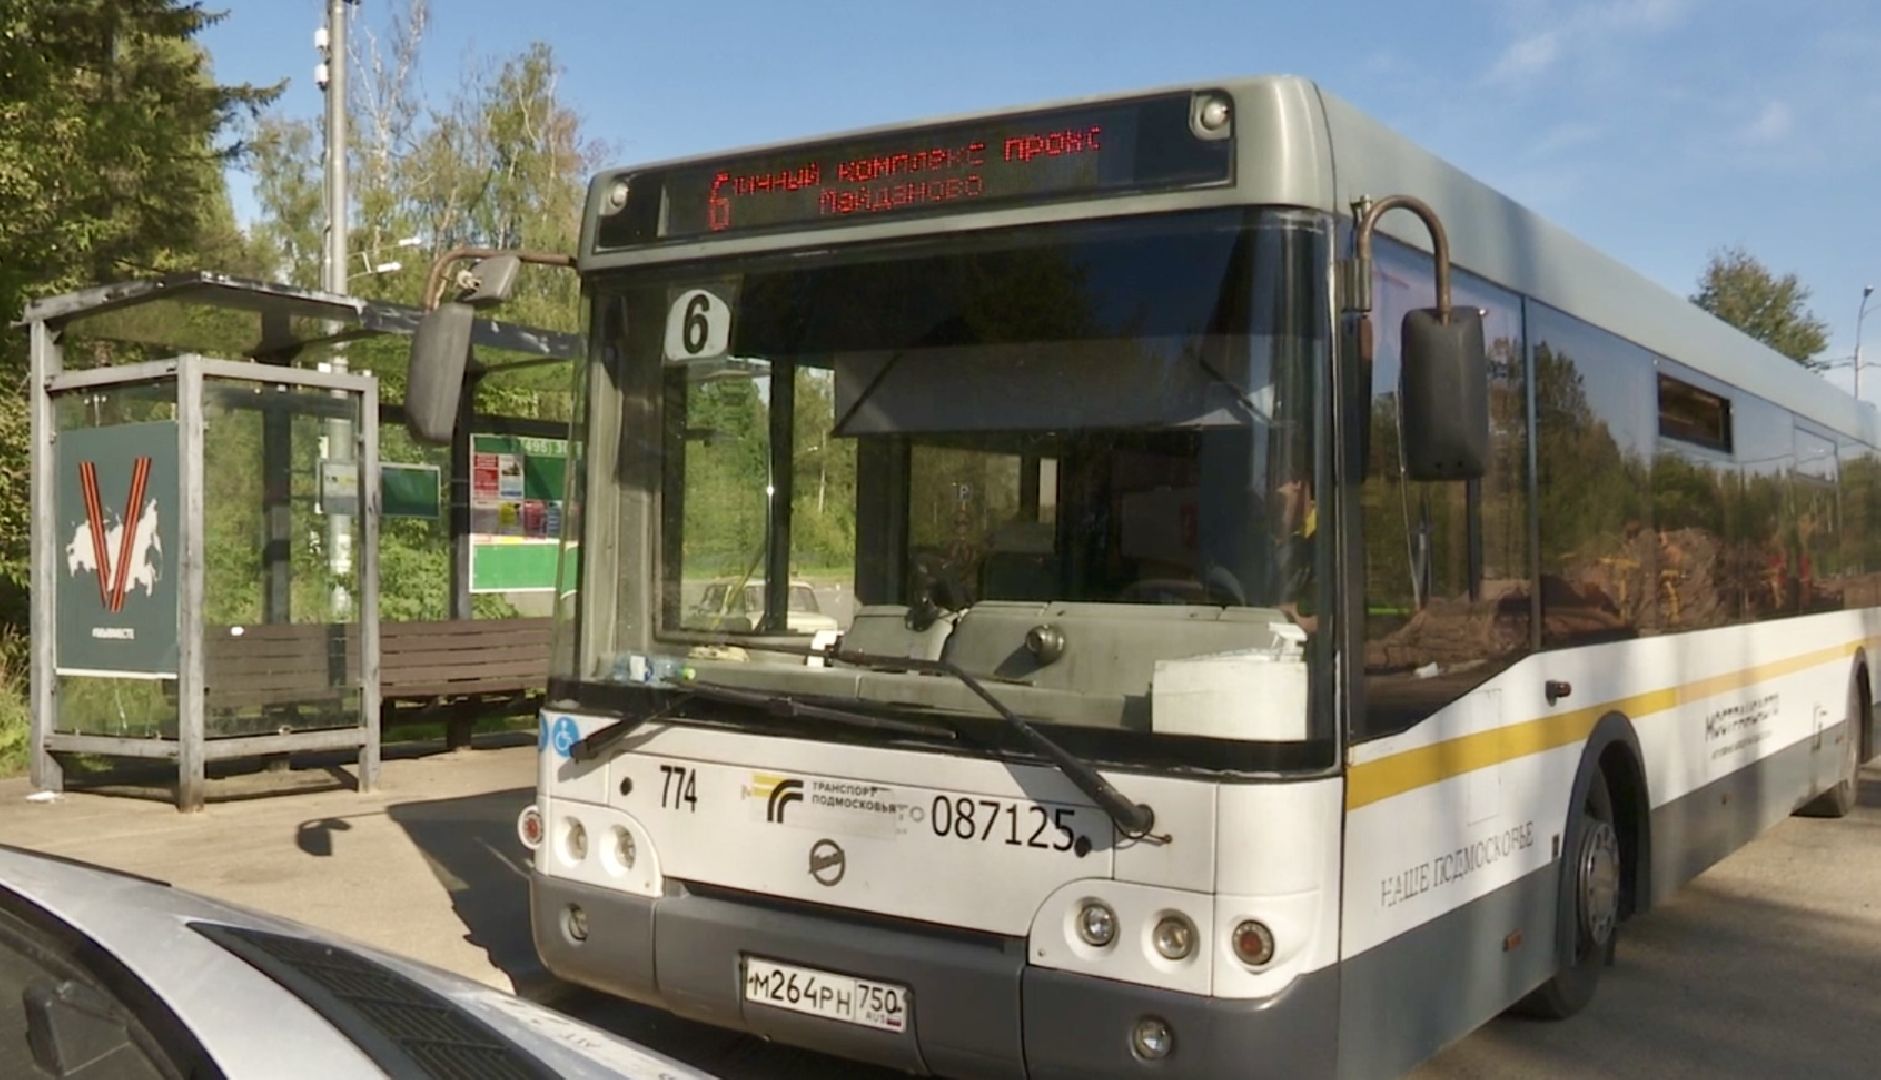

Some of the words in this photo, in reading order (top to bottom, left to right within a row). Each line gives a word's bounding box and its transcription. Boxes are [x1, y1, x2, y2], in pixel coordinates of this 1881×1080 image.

[708, 172, 730, 232] 6
[734, 162, 820, 197] ичный
[684, 293, 710, 354] 6
[660, 764, 697, 814] 774
[813, 781, 878, 799] ТРАНСПОРТ
[932, 795, 1075, 851] 087125
[754, 969, 851, 1016] М264РН
[858, 984, 898, 1014] 750
